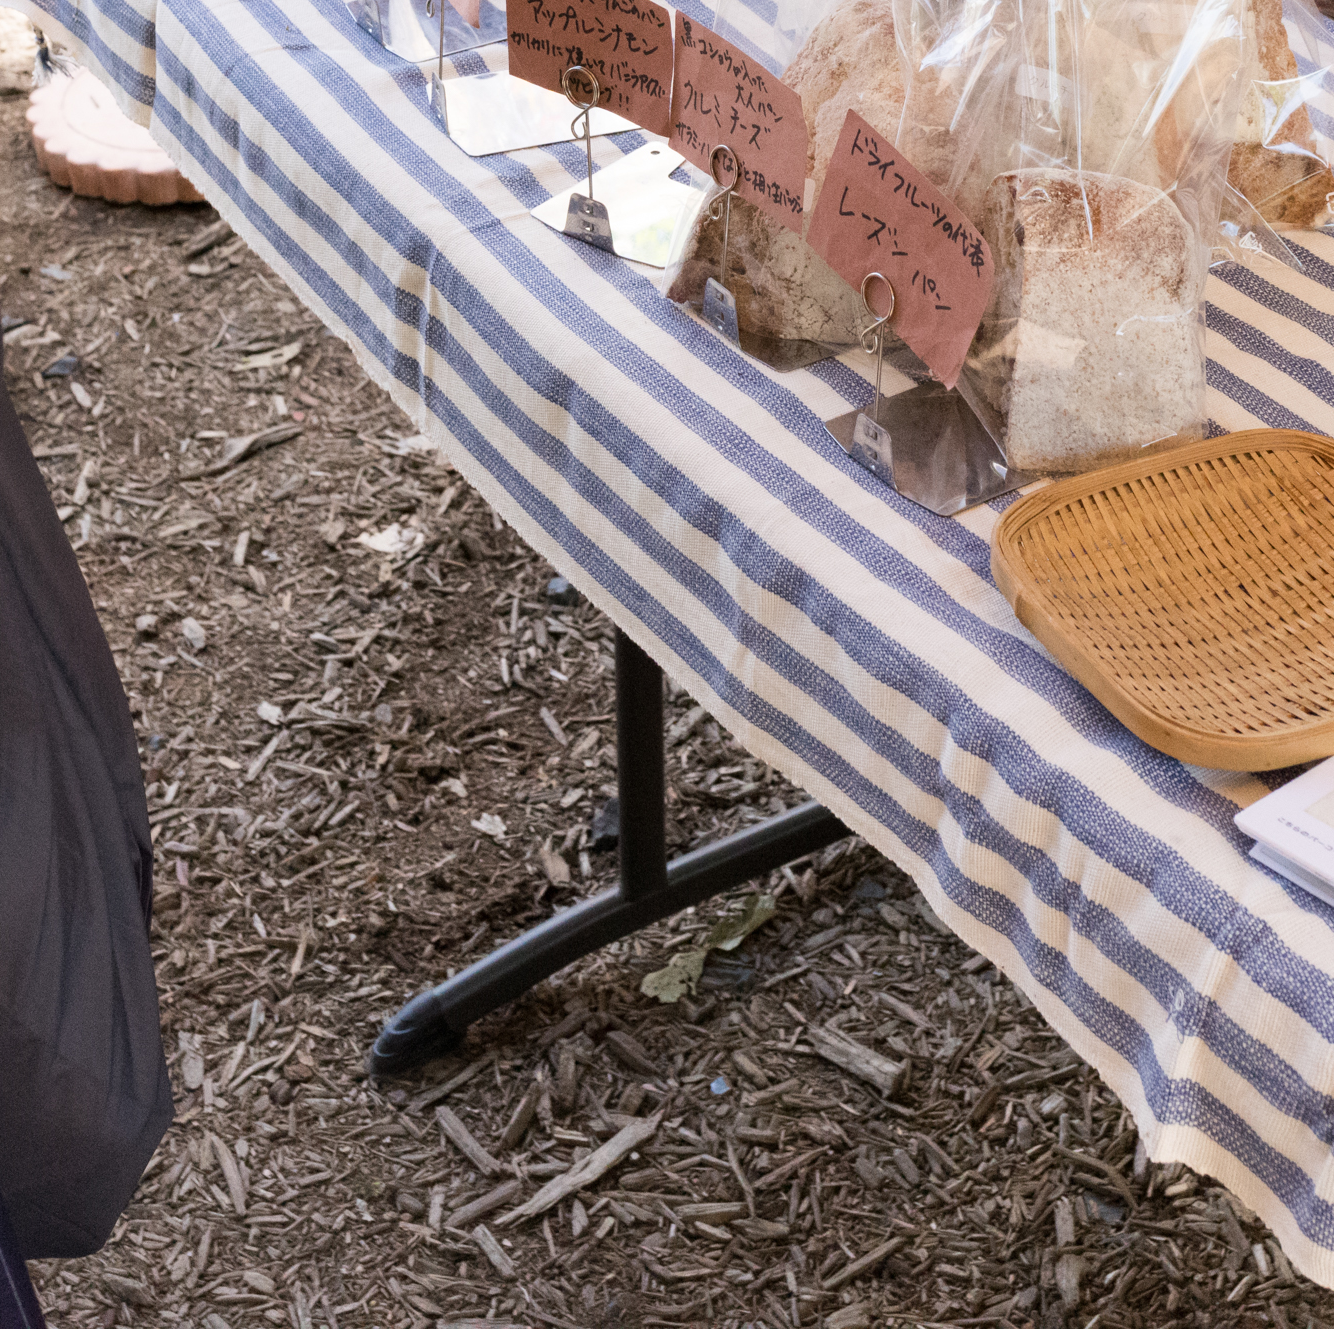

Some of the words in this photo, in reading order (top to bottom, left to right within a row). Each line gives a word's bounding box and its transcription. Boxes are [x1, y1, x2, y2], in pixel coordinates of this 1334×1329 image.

[838, 185, 909, 257] レーズン
[911, 270, 952, 311] パン
